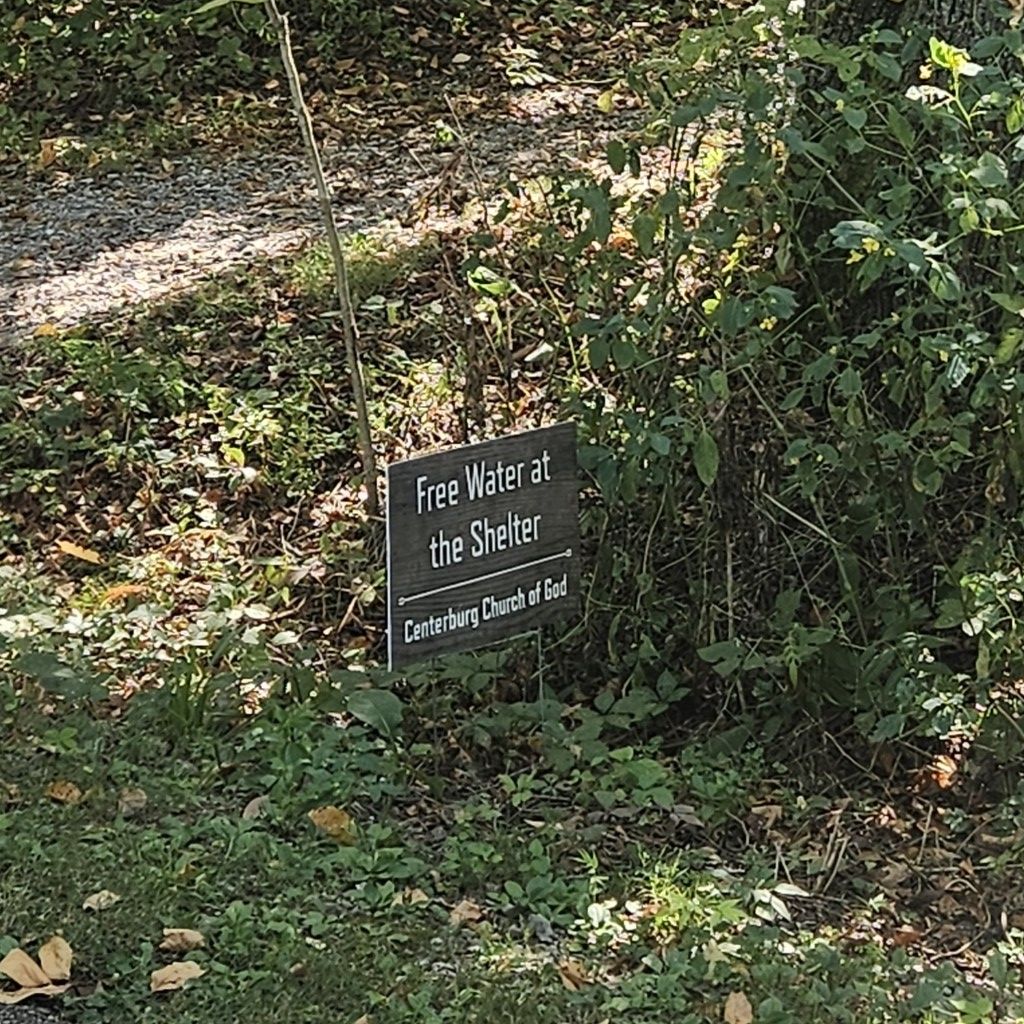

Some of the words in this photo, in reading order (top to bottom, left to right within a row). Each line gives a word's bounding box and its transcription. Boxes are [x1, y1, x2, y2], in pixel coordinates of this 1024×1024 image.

[416, 476, 459, 514] Free
[465, 461, 525, 501] Water
[531, 450, 551, 484] at
[429, 530, 463, 569] the
[471, 511, 542, 557] Shelter
[404, 608, 479, 643] Centerburg
[482, 588, 526, 621] Church
[528, 586, 542, 606] of
[544, 573, 568, 601] God
